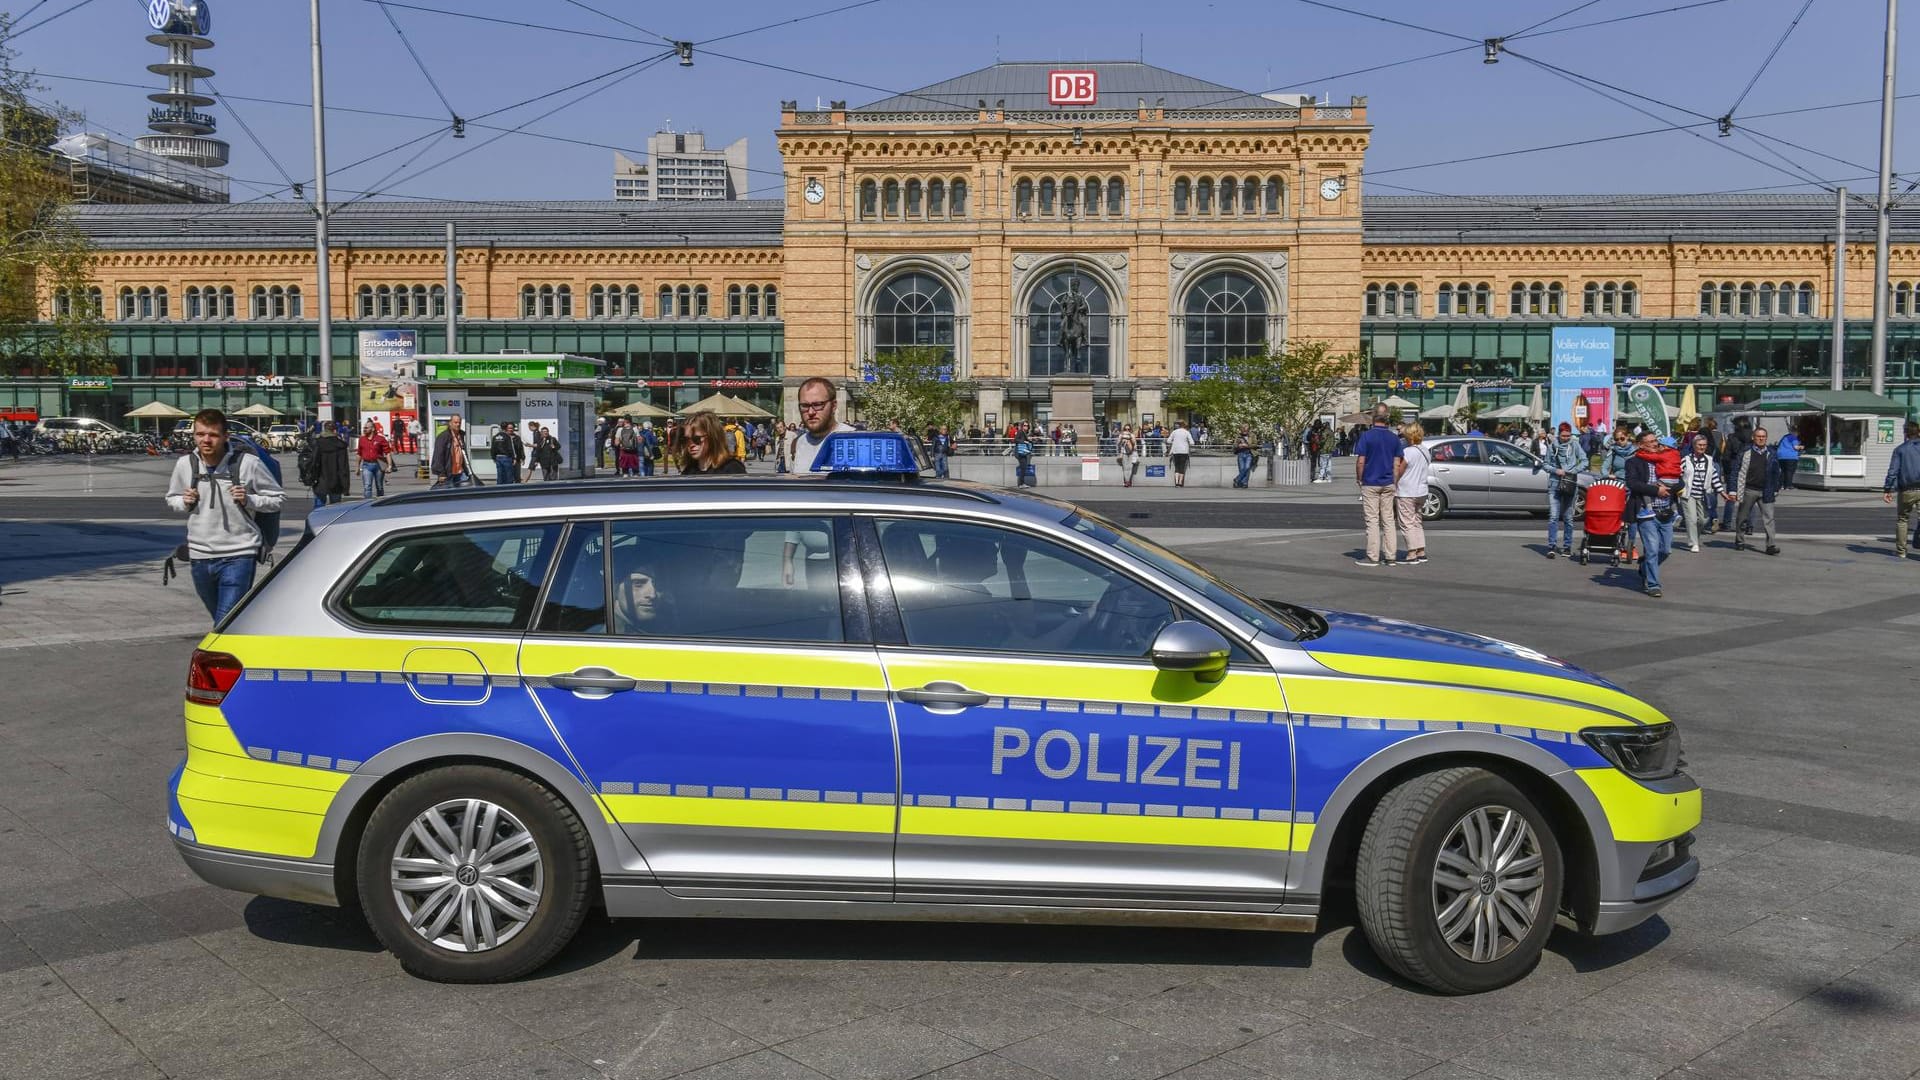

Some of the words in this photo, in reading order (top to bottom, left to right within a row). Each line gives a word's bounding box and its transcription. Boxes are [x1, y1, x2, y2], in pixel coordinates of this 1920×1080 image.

[1055, 76, 1092, 99] DB
[363, 338, 413, 347] Entscheiden
[1556, 338, 1580, 350] Voller
[363, 349, 375, 357] ist
[375, 348, 407, 357] einfach.
[1555, 352, 1584, 363] Milder
[457, 361, 527, 374] Fahrkarten
[525, 399, 553, 408] ÜSTRA
[991, 726, 1241, 790] POLIZEI
